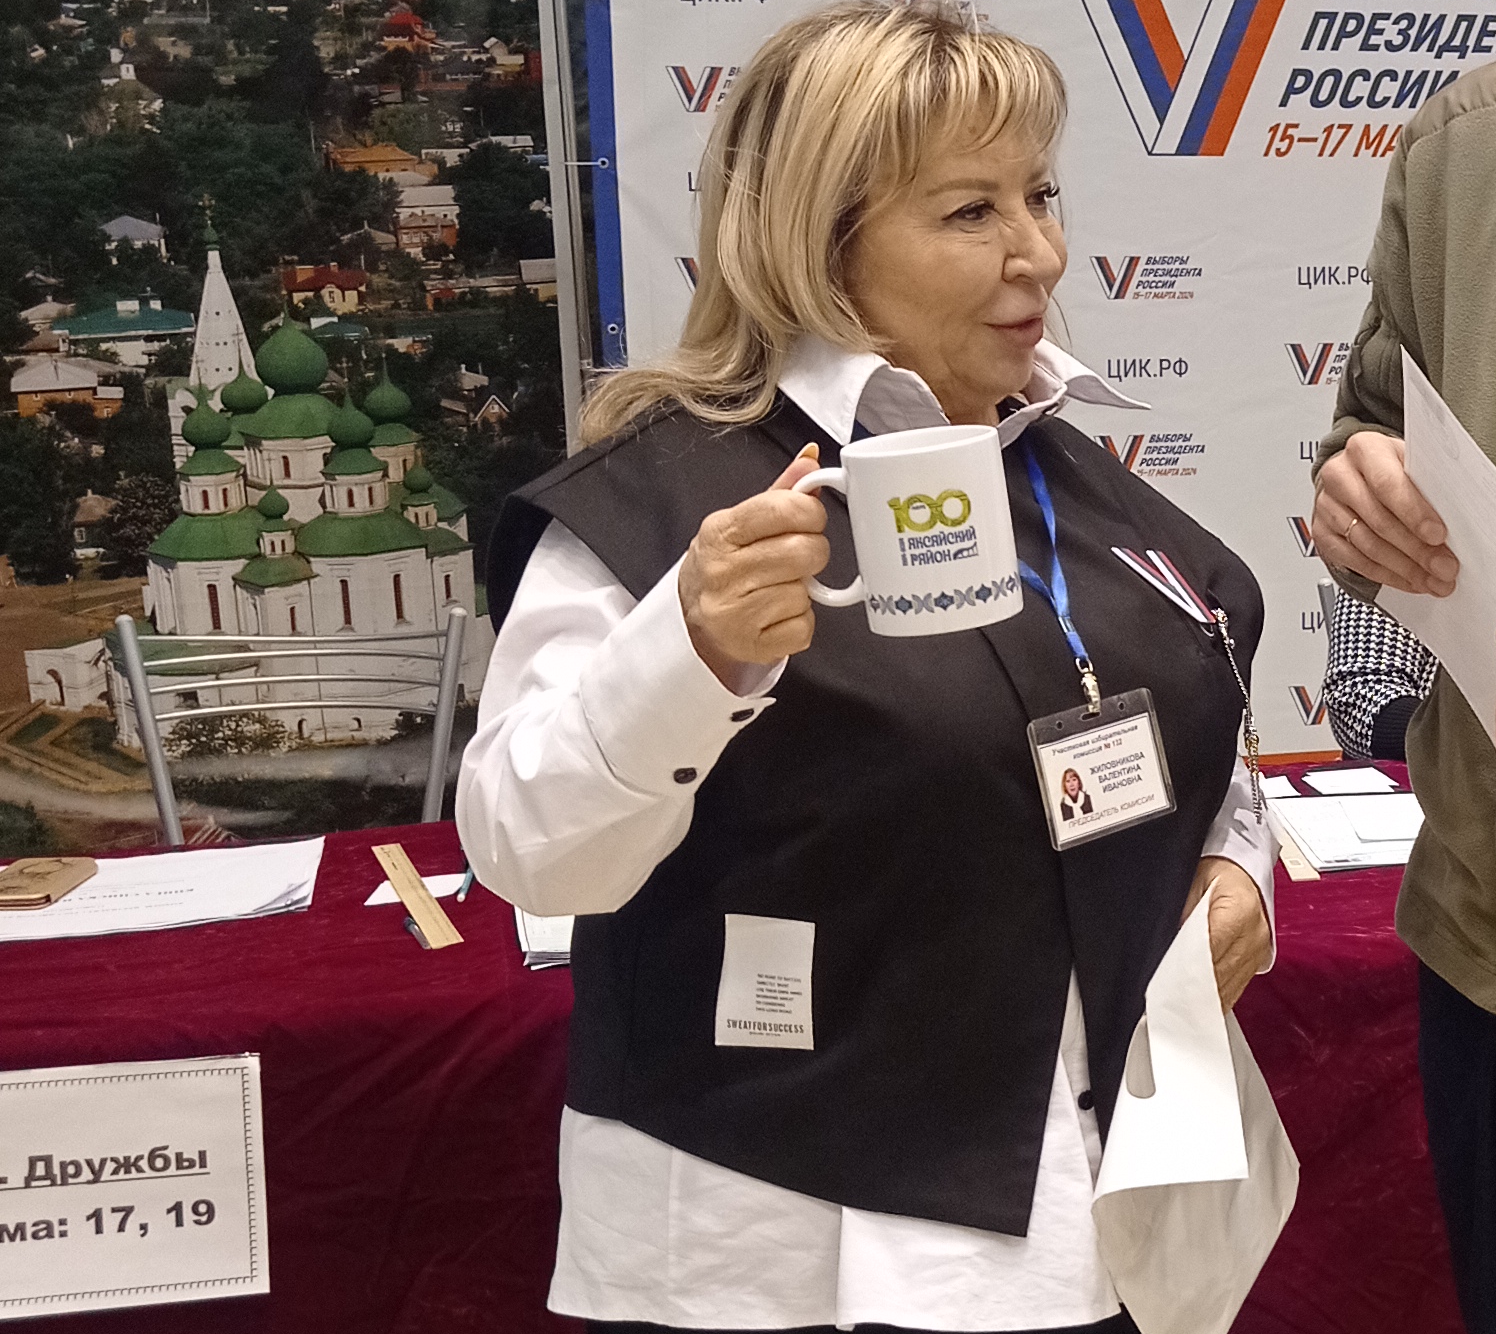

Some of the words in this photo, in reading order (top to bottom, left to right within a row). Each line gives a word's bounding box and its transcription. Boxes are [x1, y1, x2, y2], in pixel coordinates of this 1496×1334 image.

[1145, 256, 1190, 265] ВЫБОРЫ
[1140, 268, 1202, 278] ПРЕЗИДЕНТА
[1136, 280, 1176, 289] РОССИИ
[1107, 358, 1189, 383] ЦИК.РФ
[1149, 433, 1193, 443] ВЫБОРЫ
[1144, 445, 1205, 455] ПРЕЗИДЕНТА
[1139, 457, 1179, 467] РОССИИ
[1089, 751, 1145, 775] ЖИЛОВНИКОВА
[1098, 764, 1142, 783] ВАЛЕНТИНА
[1102, 774, 1143, 793] ИВАНОВНА
[1068, 806, 1120, 828] ПРЕДСЕДАТЕЛЬ
[1120, 794, 1155, 811] КОМИССИИ
[24, 1145, 208, 1188] Дружбы
[86, 1205, 149, 1238] 17,
[166, 1199, 216, 1227] 19
